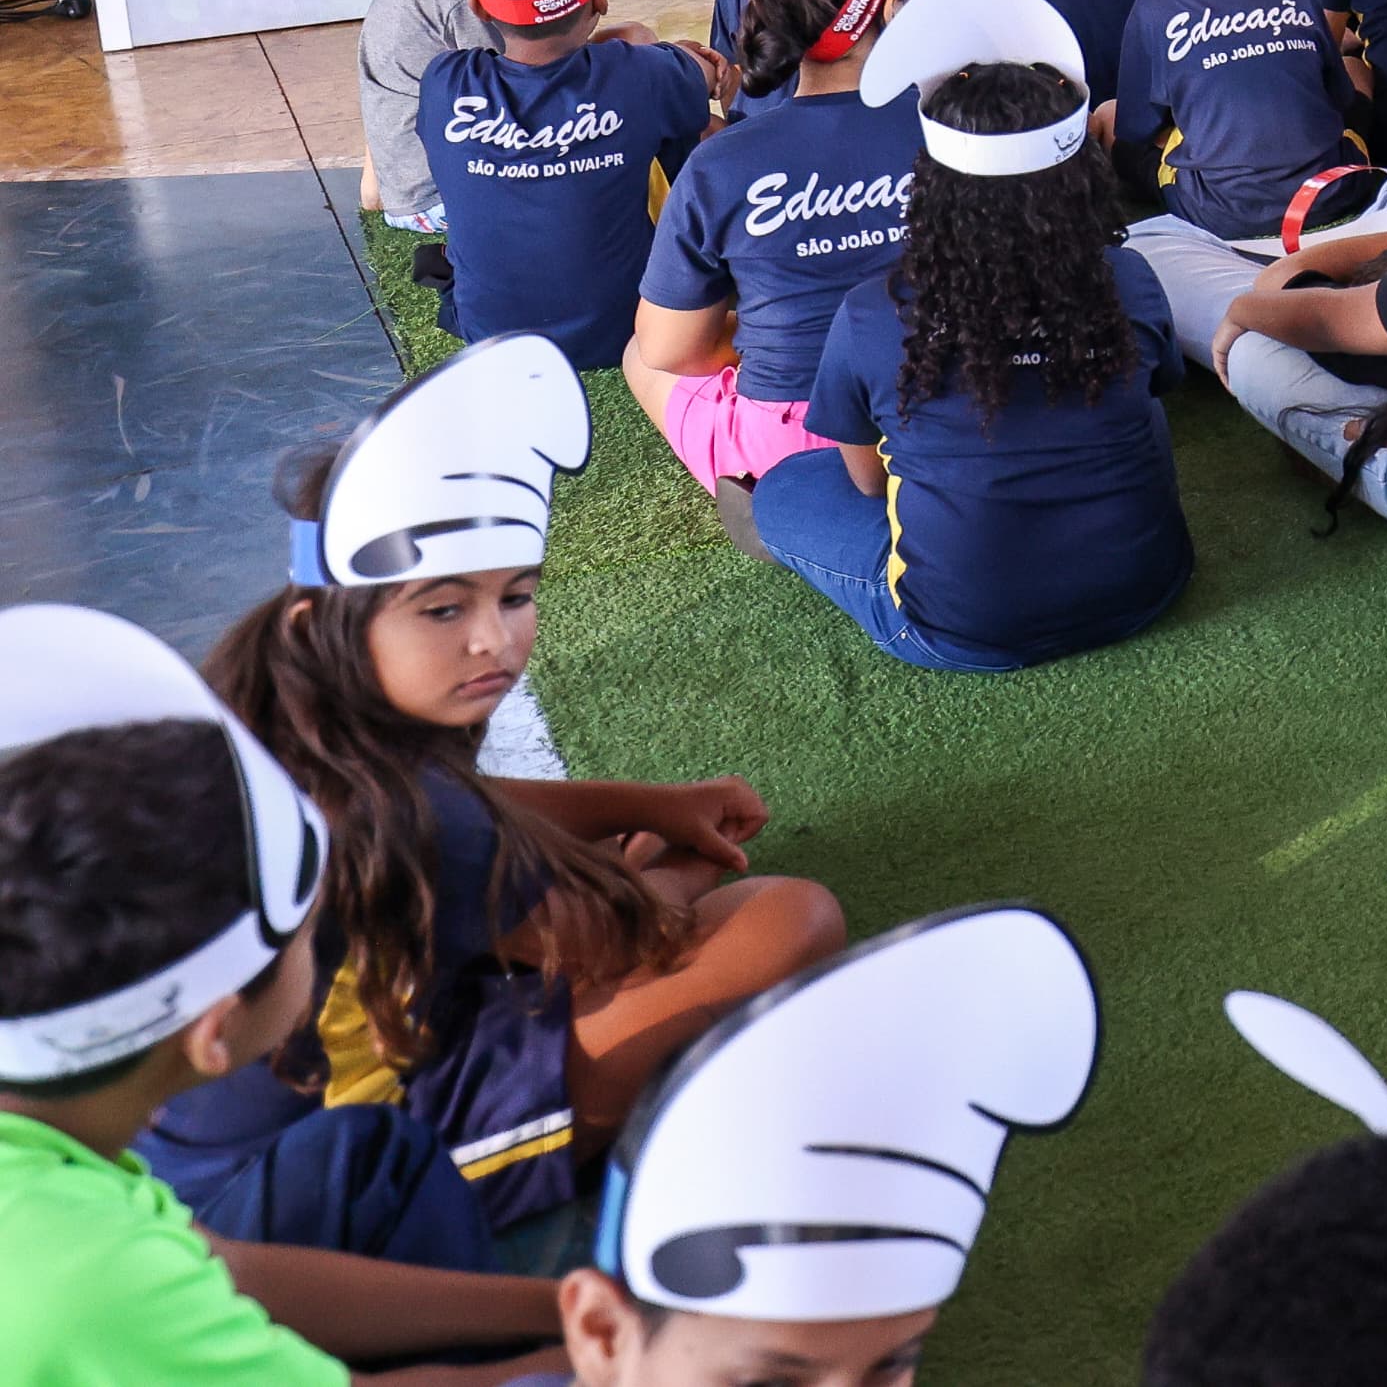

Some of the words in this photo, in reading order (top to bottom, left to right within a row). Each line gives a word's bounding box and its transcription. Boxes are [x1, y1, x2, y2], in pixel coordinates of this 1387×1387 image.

[1166, 0, 1314, 62] Educação
[1202, 53, 1228, 70] SÃO
[1230, 44, 1265, 61] JOÃO
[1267, 40, 1285, 54] DO
[445, 96, 623, 157] Educação
[467, 159, 494, 176] SÃO
[498, 162, 539, 178] JOÃO
[543, 162, 566, 177] DO
[796, 238, 833, 257] SÃO
[837, 229, 885, 251] JOÃO
